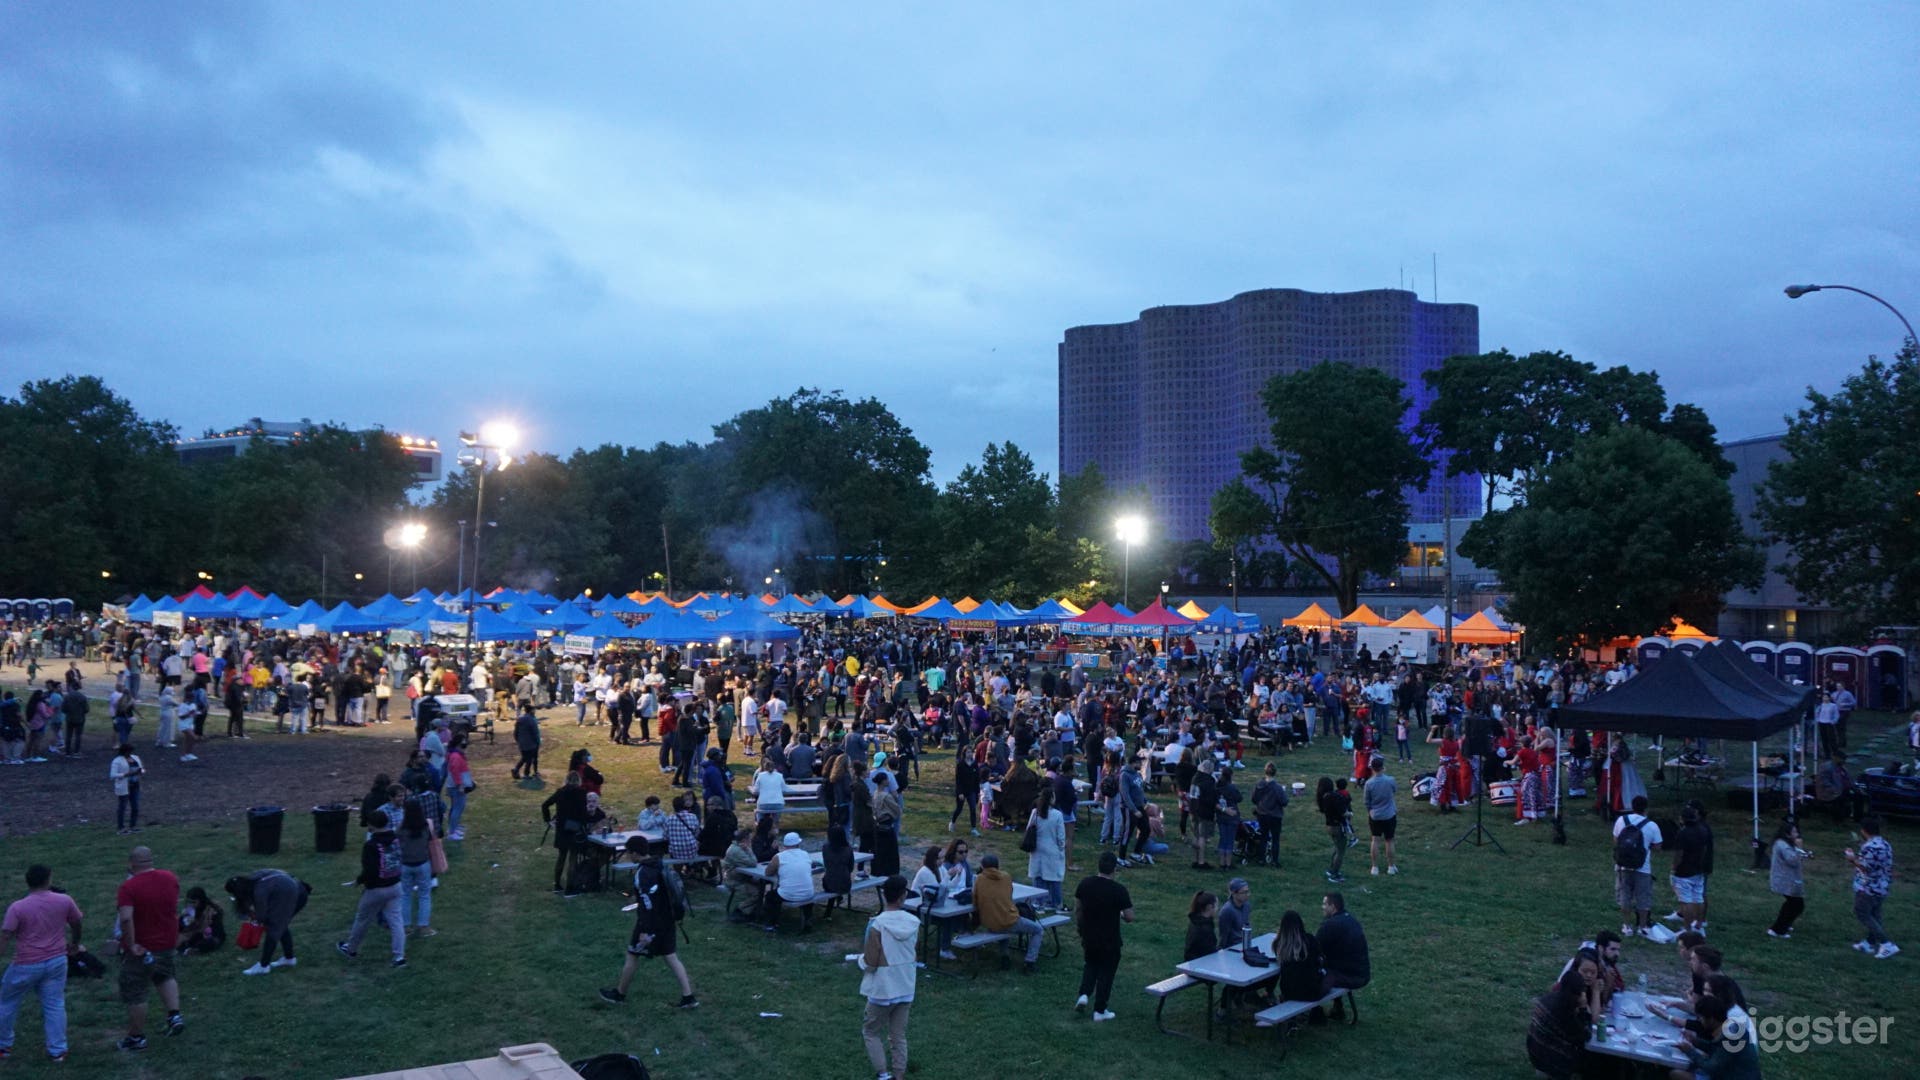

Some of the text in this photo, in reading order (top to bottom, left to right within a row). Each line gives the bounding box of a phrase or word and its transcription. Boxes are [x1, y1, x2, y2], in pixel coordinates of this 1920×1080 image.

[1063, 622, 1081, 632] BEER
[1089, 623, 1111, 633] WINE
[1114, 624, 1134, 633] BEER
[1141, 625, 1164, 634] WINE
